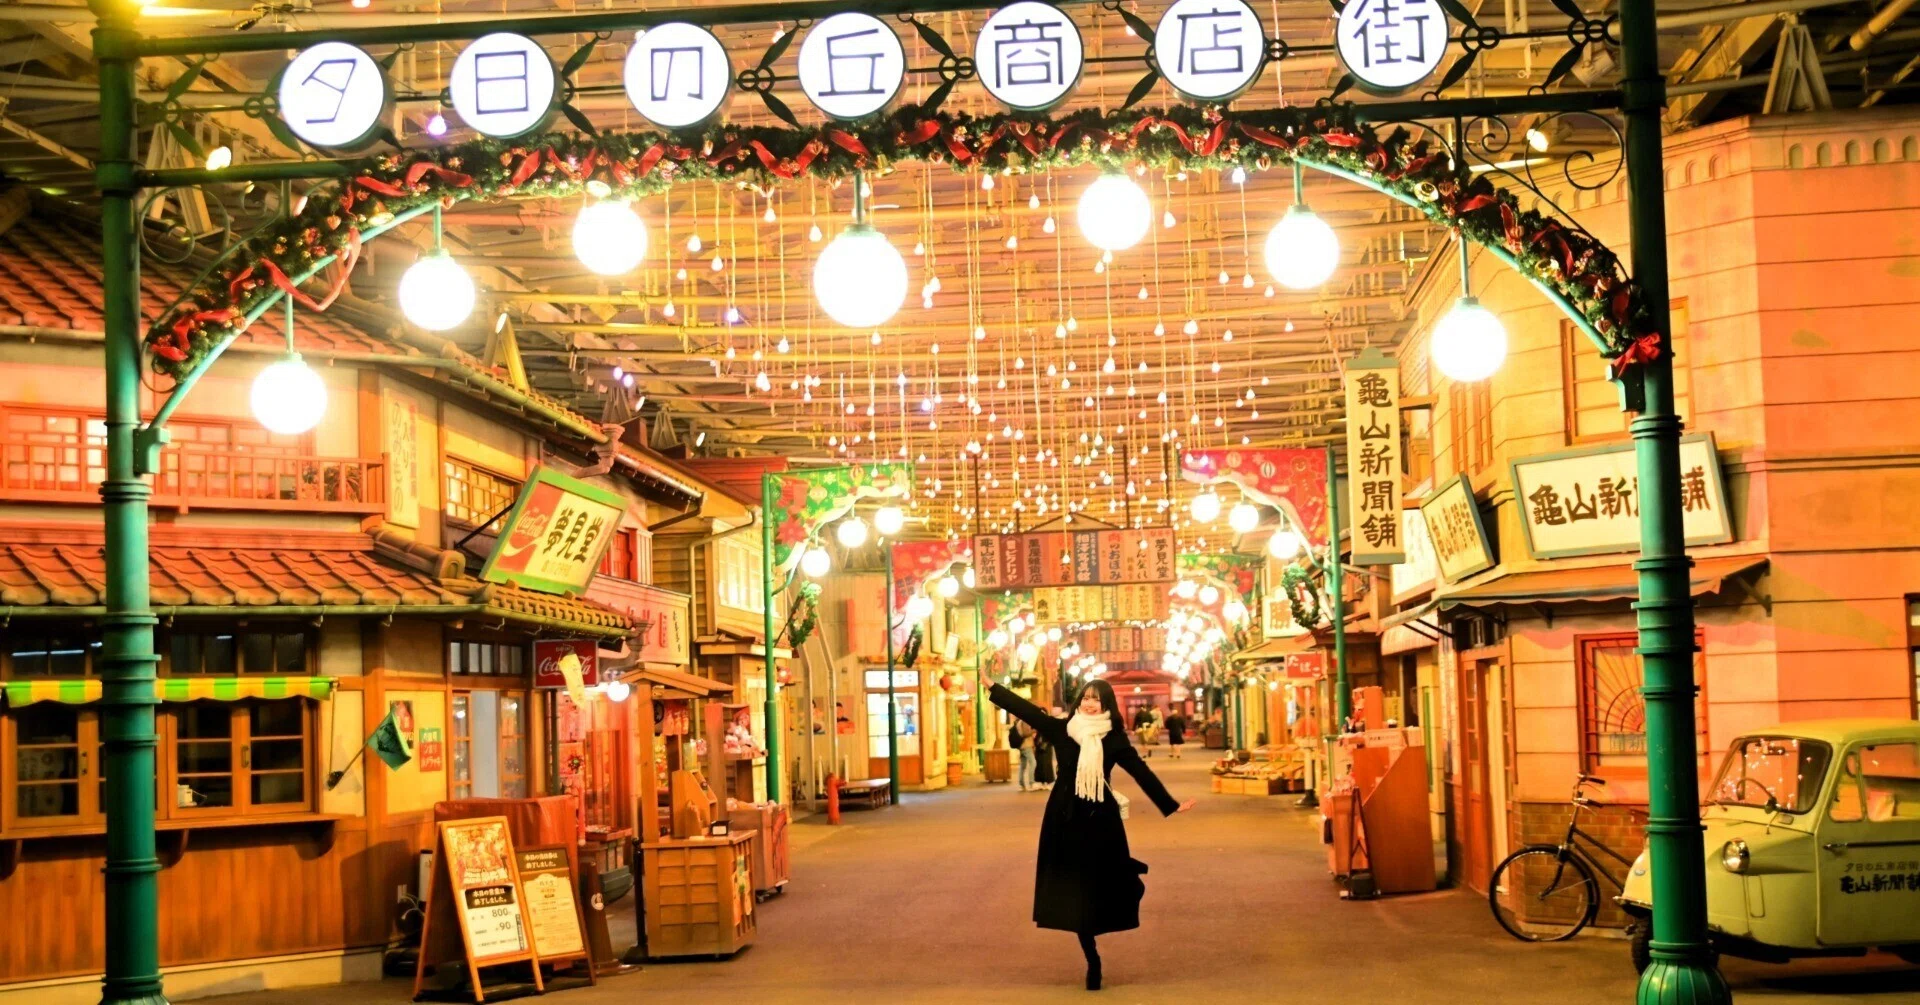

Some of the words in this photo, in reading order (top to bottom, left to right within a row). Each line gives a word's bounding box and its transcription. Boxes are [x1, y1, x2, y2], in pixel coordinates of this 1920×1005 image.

[302, 0, 1430, 125] 夕日の丘商店街
[543, 507, 604, 563] 夢見堂
[1155, 538, 1169, 578] 夢見堂
[1288, 655, 1322, 677] たばこ
